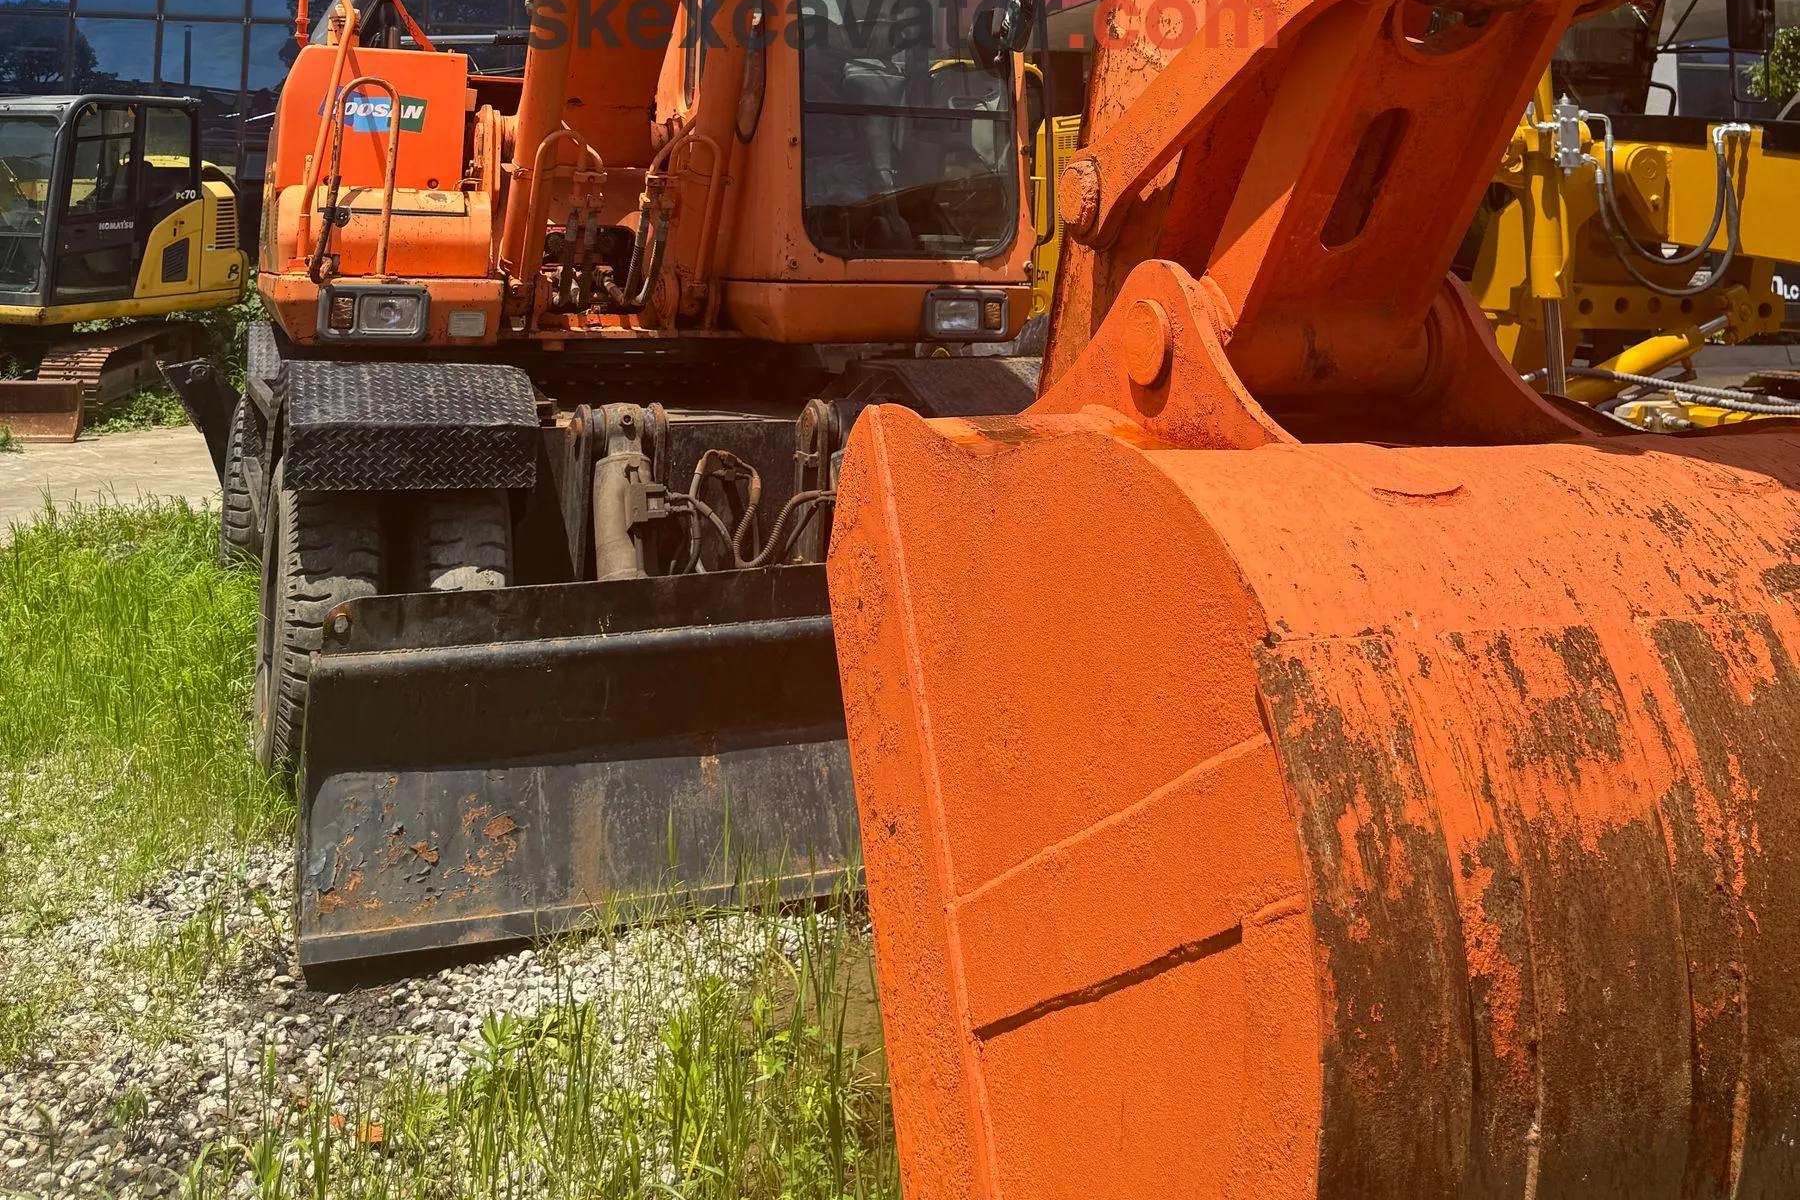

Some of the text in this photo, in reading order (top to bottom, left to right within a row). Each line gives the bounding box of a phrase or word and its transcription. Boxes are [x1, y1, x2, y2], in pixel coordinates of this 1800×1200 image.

[332, 101, 424, 119] OOSN
[175, 189, 197, 200] PC70
[98, 220, 134, 231] KOMATSU
